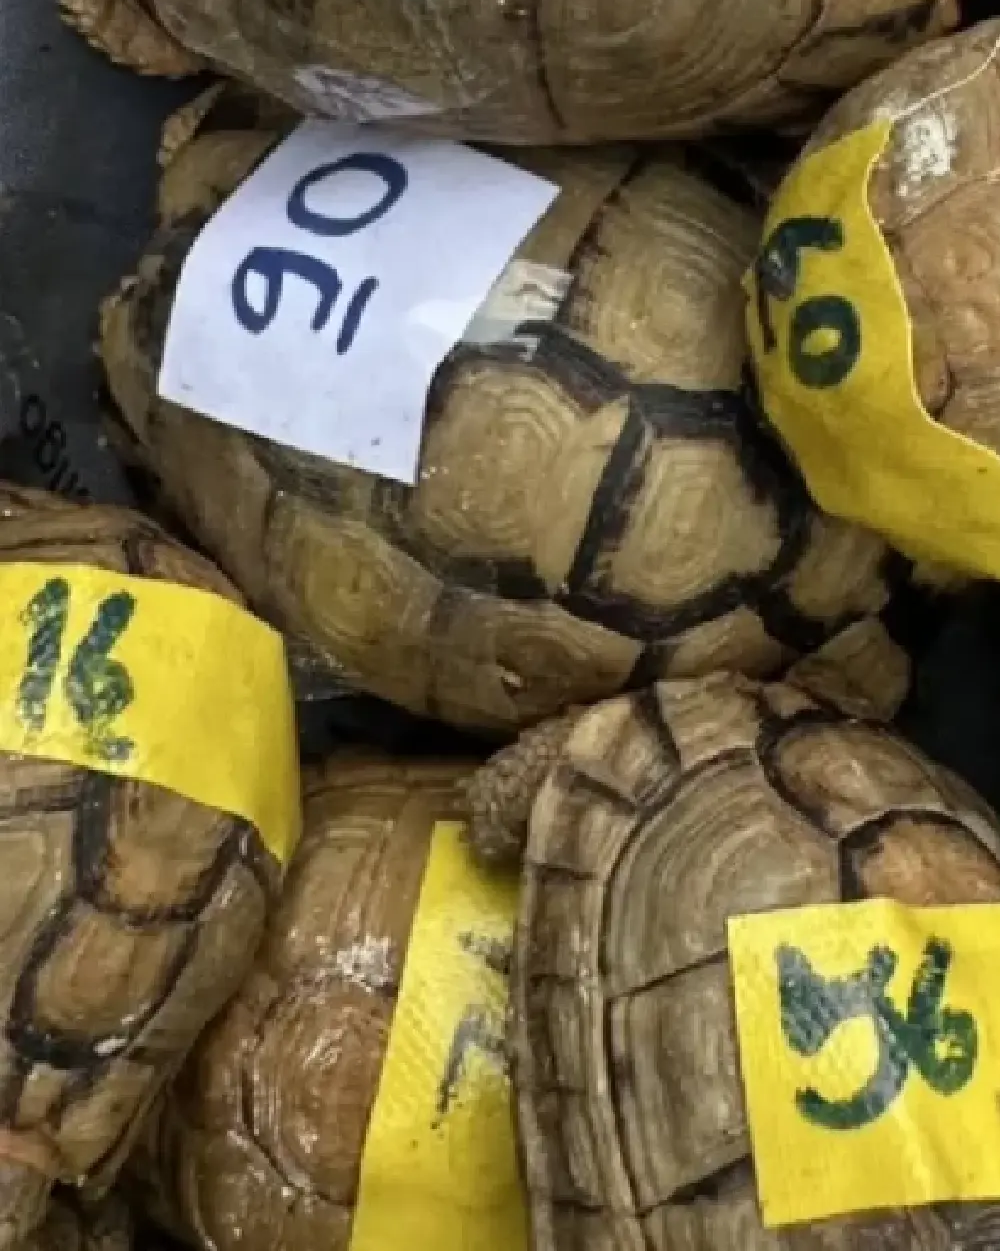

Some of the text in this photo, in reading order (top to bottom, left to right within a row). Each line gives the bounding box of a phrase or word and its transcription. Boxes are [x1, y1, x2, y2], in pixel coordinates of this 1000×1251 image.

[231, 152, 408, 354] 90
[14, 577, 136, 761] 16
[773, 934, 978, 1128] 56
